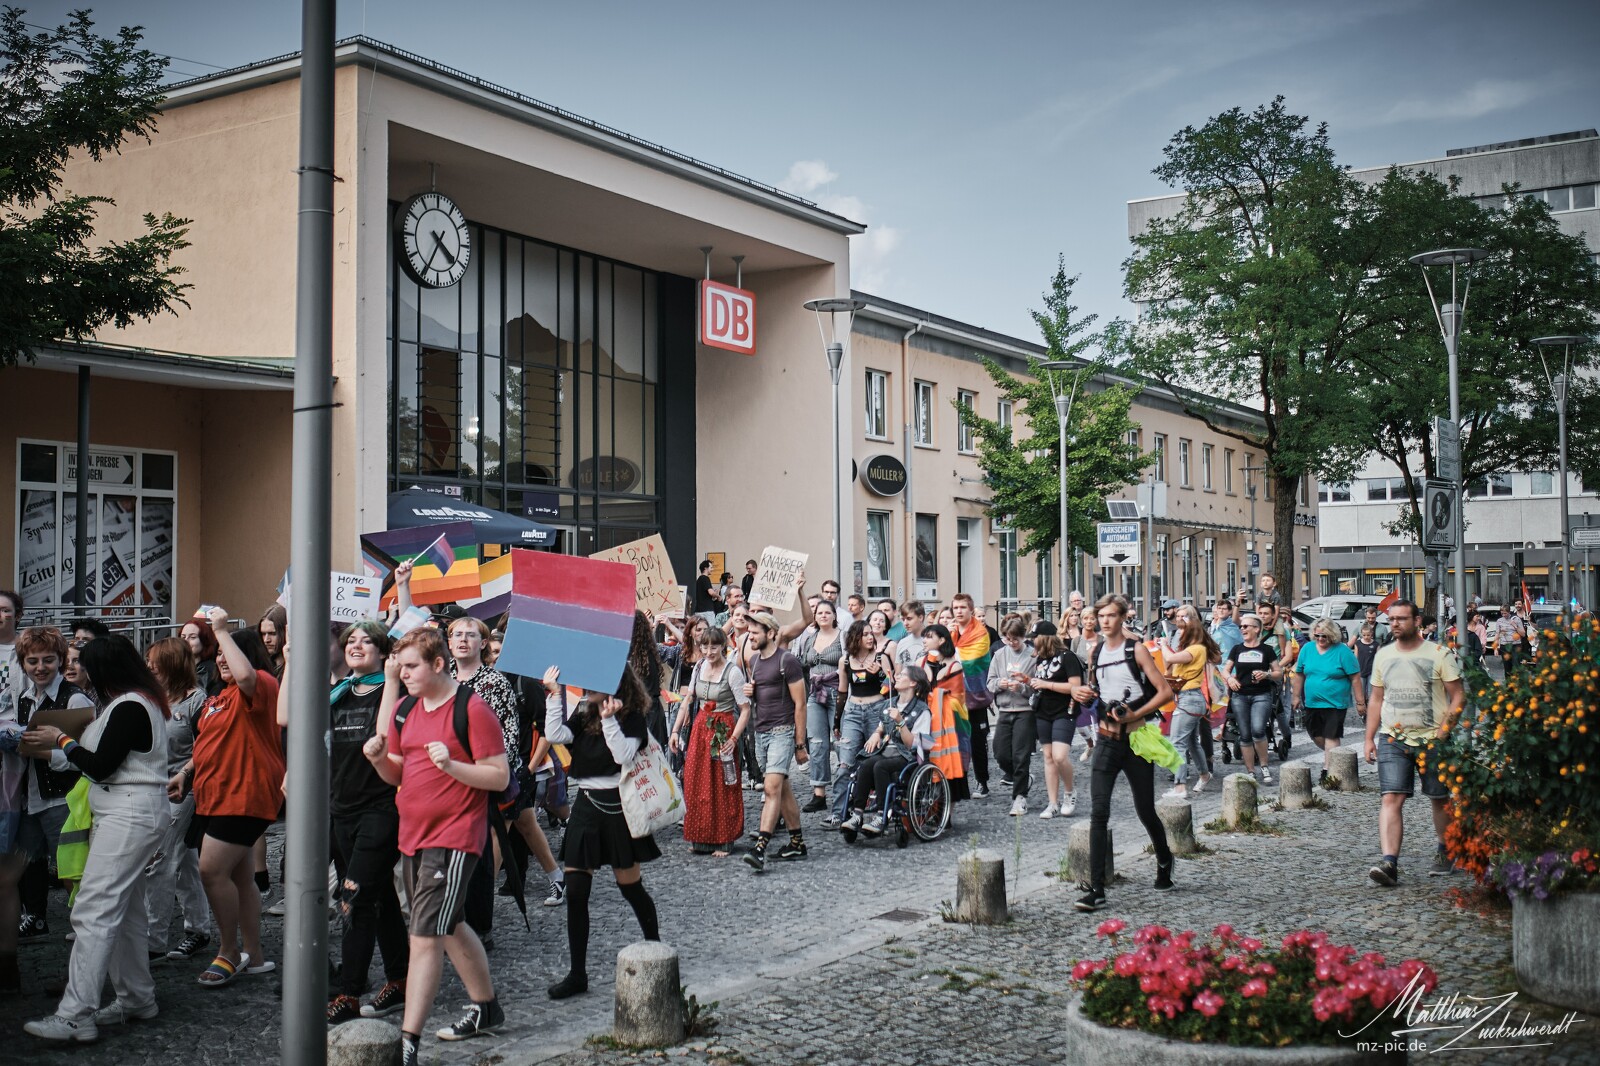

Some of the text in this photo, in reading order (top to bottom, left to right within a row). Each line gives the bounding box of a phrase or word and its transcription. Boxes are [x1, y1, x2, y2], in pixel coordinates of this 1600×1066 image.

[711, 292, 749, 342] DB
[68, 453, 120, 468] INN. PRESSE
[68, 467, 103, 480] ZEGEN
[870, 465, 898, 482] MÜLLER
[412, 506, 494, 519] LAVAZZA
[521, 529, 547, 539] LAVAZZA
[1100, 525, 1137, 534] PARKSCHEIN-
[1105, 533, 1132, 542] AUTOMAT
[1433, 532, 1449, 542] ZONE
[760, 553, 804, 574] KNABBER
[19, 556, 74, 589] Zeitug
[760, 569, 795, 588] AN MIR
[337, 575, 365, 585] HOMO
[335, 586, 346, 601] &
[331, 606, 358, 618] SECCO
[1390, 693, 1422, 701] GOODS
